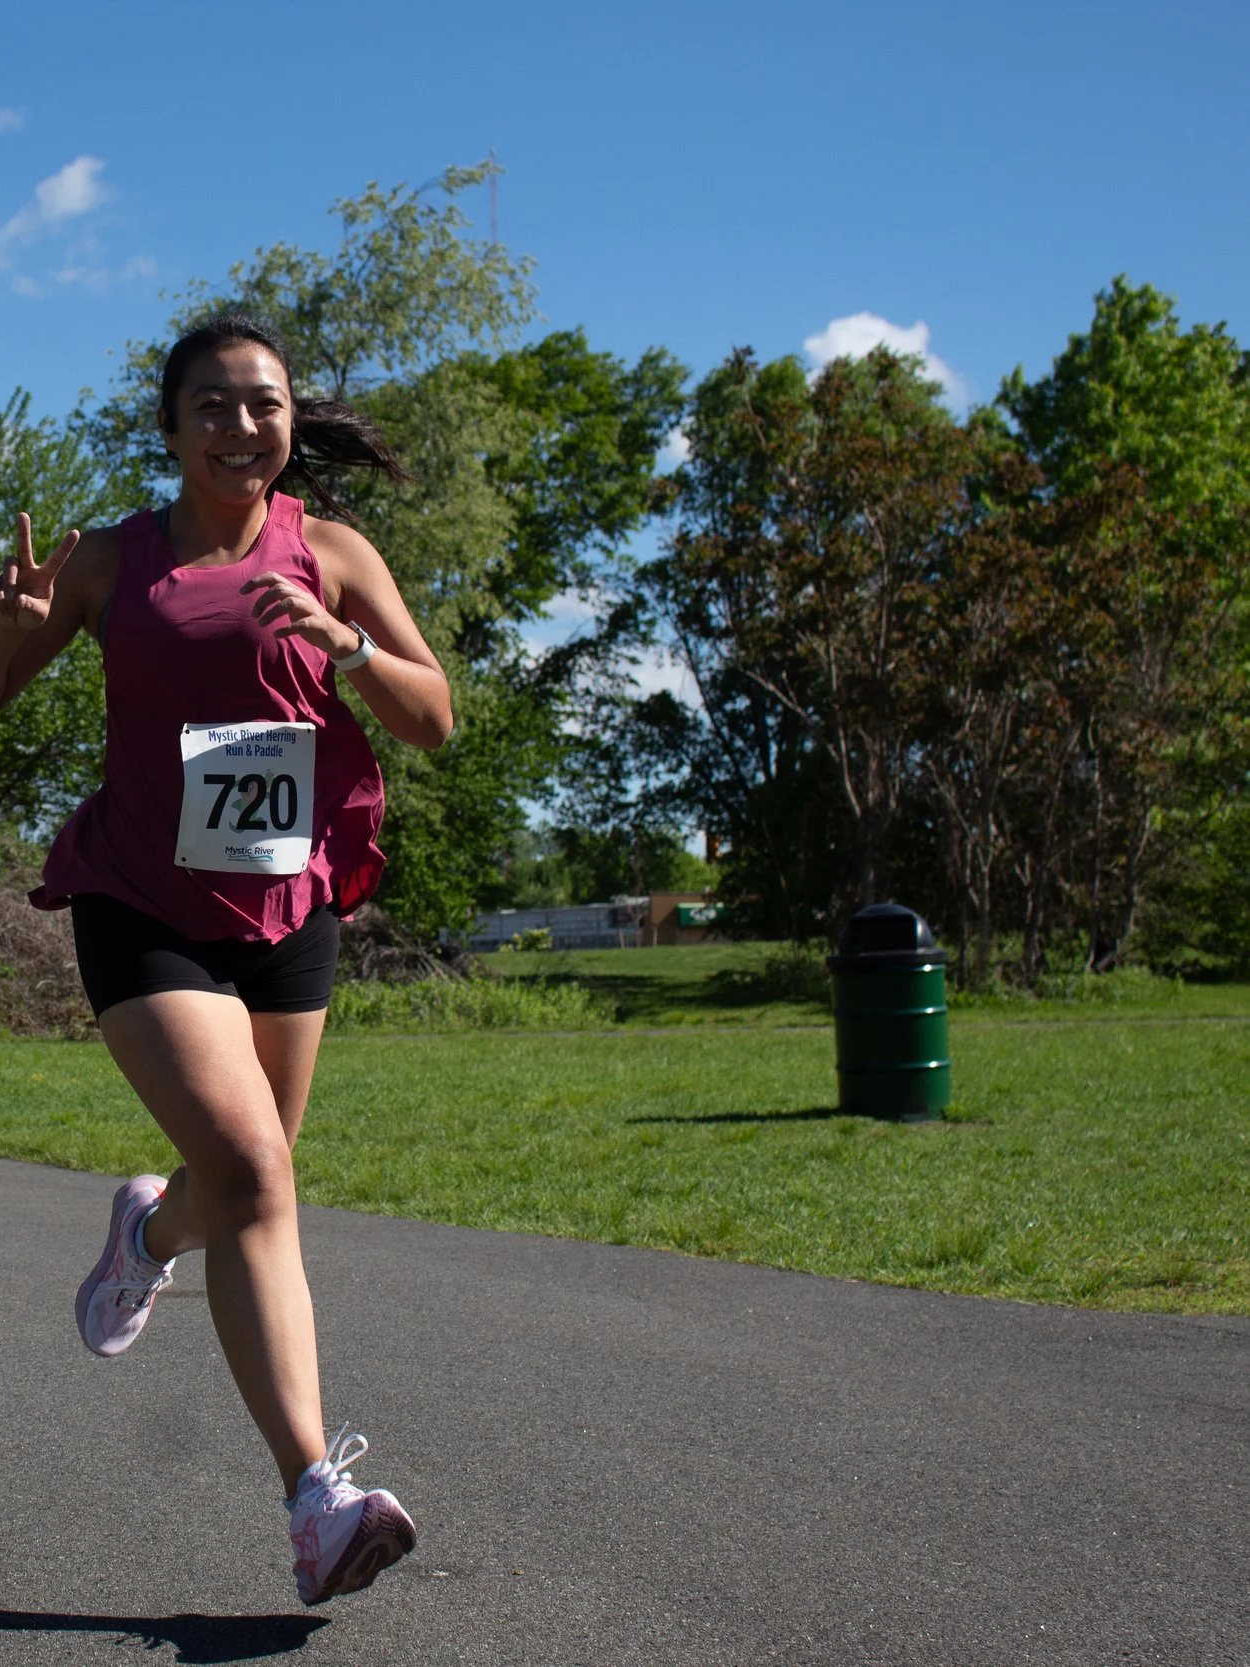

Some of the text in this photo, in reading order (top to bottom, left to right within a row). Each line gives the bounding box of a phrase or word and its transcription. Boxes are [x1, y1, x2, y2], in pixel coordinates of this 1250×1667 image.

[208, 729, 296, 744] Mystic River Herring
[225, 744, 283, 757] Run & Paddle
[203, 774, 298, 831] 720
[225, 846, 275, 857] Mystic River
